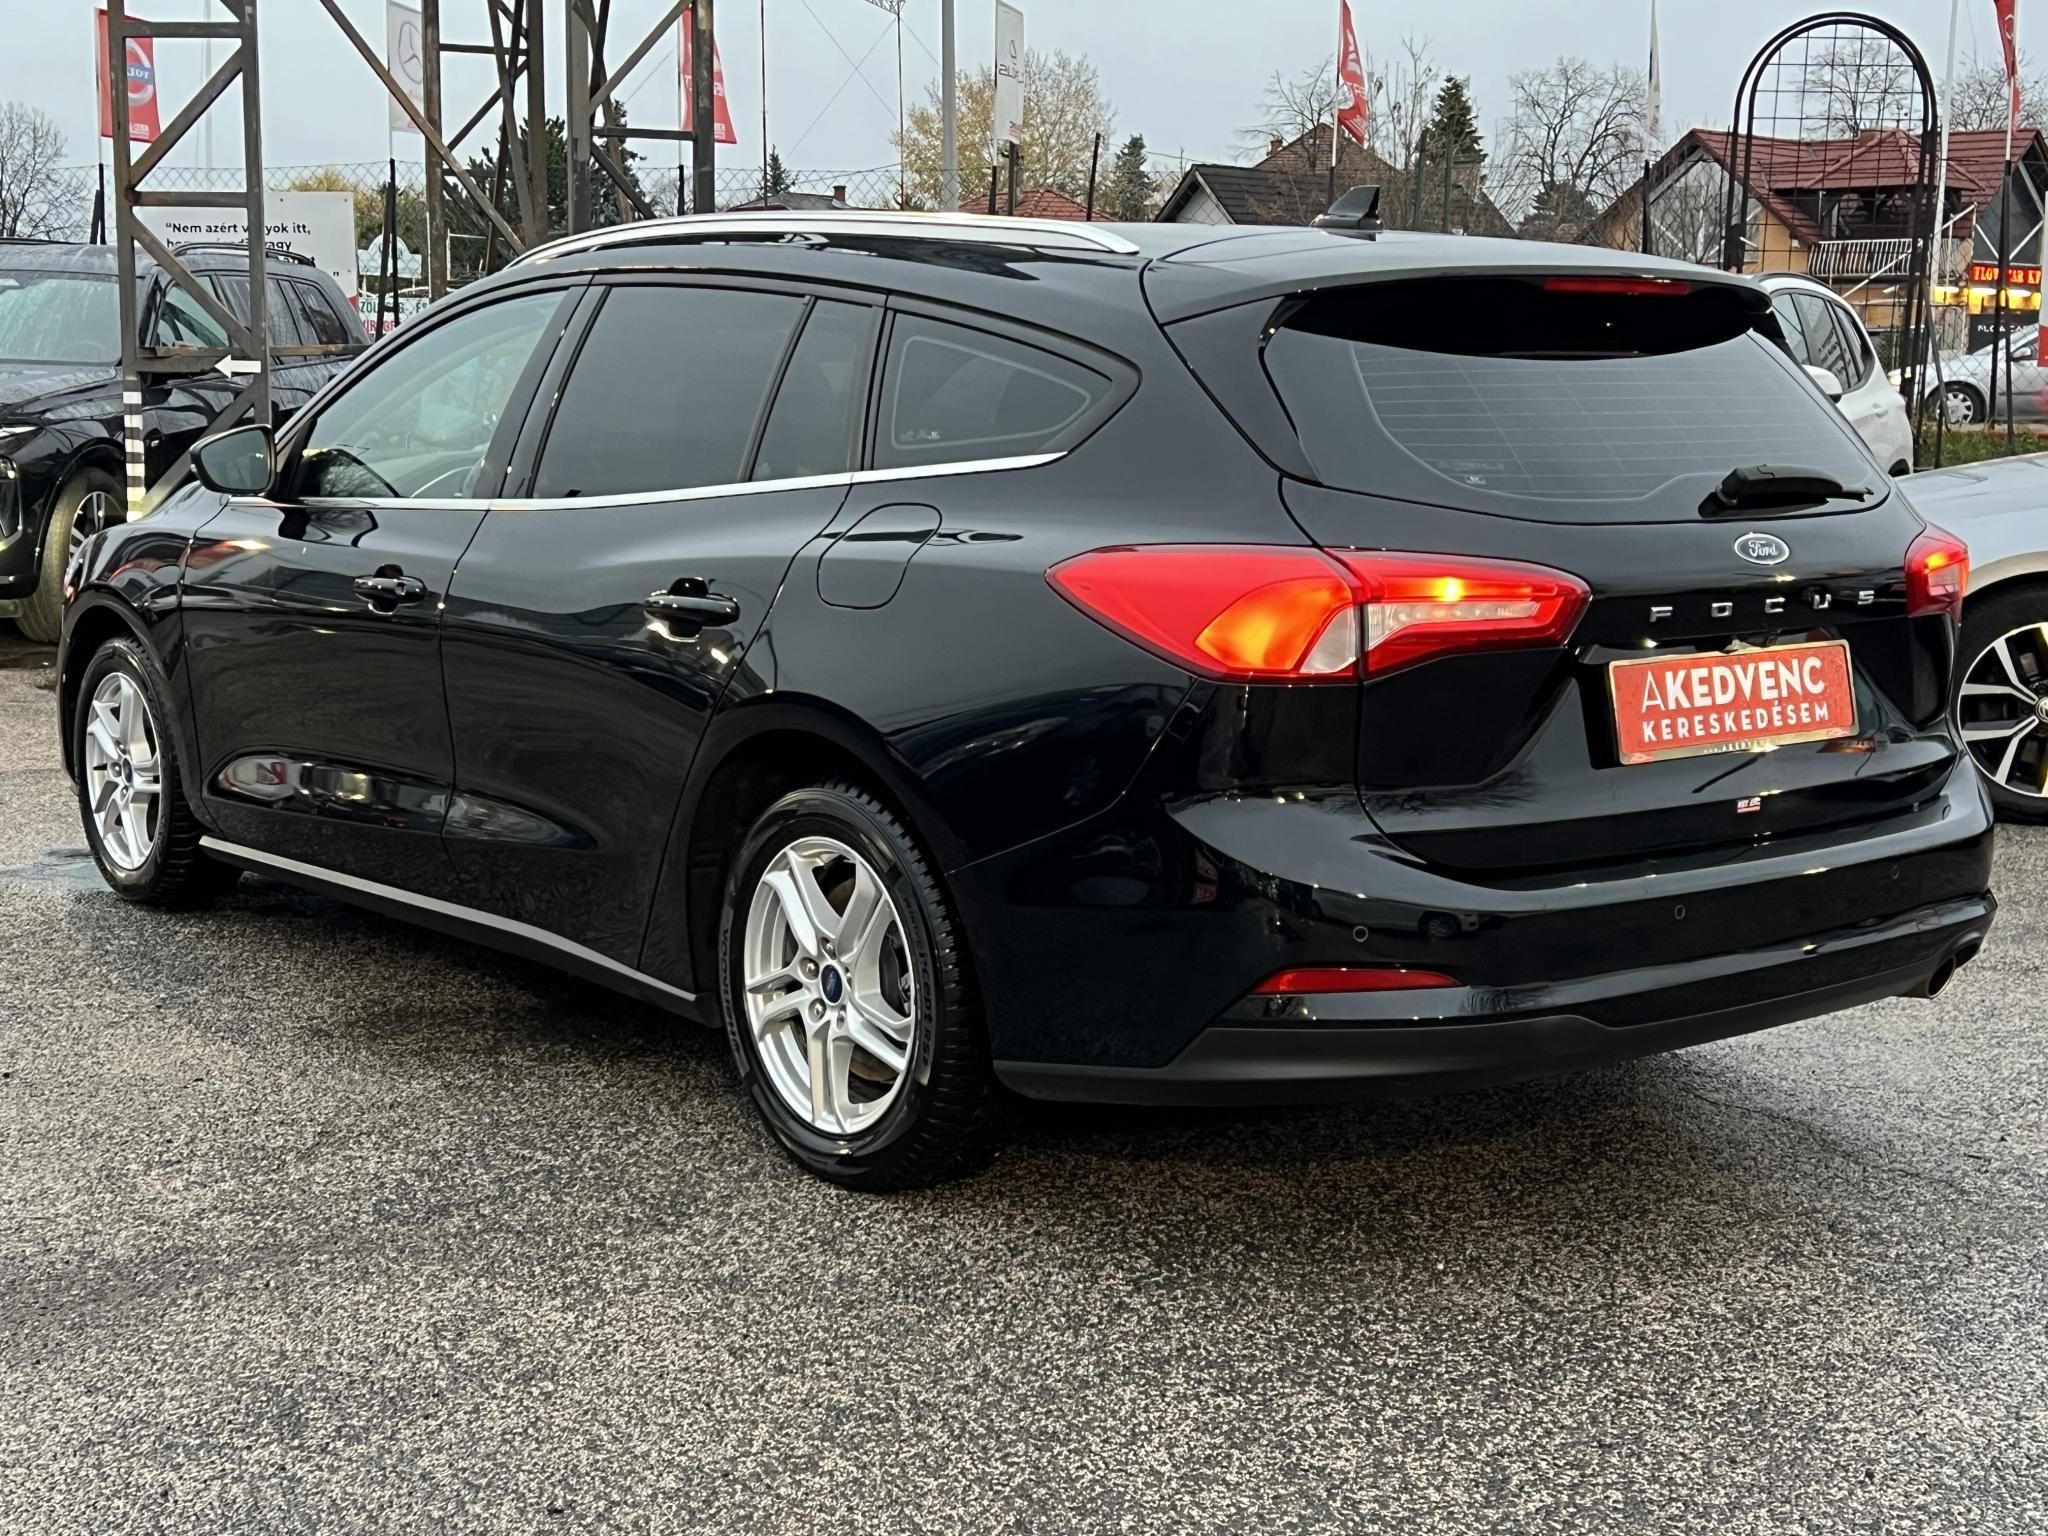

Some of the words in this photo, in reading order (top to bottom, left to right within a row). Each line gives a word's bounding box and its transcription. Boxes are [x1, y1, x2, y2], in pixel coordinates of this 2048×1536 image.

[205, 222, 238, 233] azért
[241, 225, 289, 235] vyok
[292, 222, 311, 235] itt,
[1650, 590, 1875, 622] FOCUS
[1642, 700, 1829, 743] KERESKEDÉSEM
